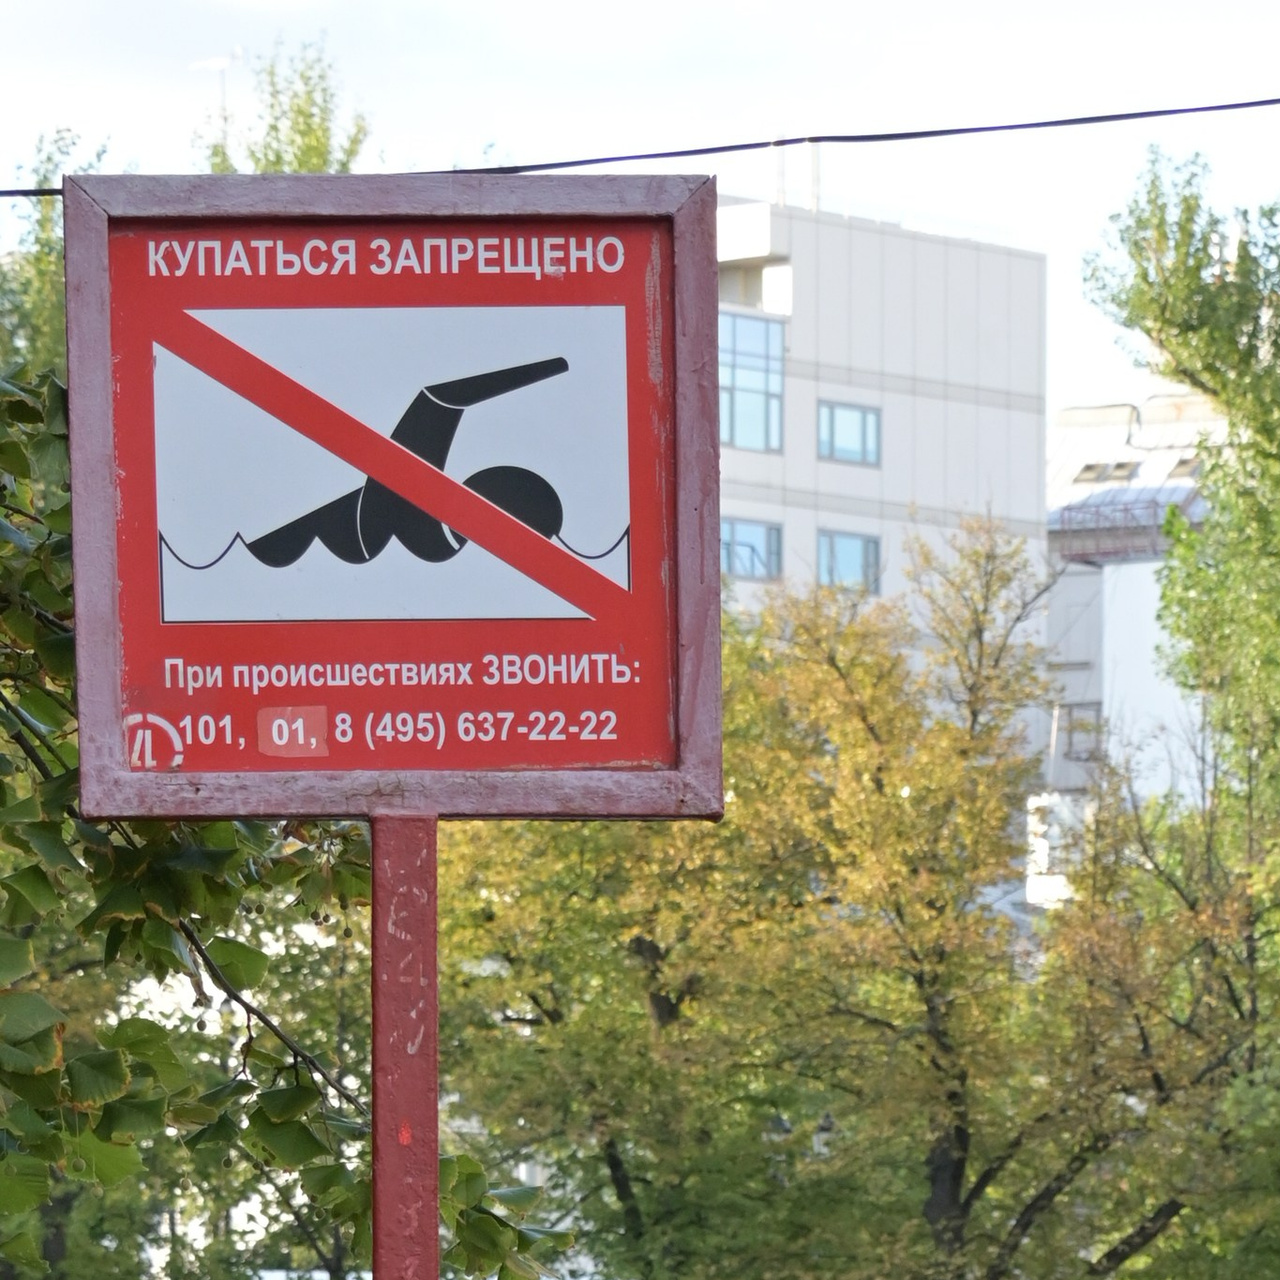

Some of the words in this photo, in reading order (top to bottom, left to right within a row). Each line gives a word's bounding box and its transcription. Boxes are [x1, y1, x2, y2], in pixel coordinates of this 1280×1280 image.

[148, 238, 357, 277] КУПАТЬСЯ
[369, 236, 625, 281] ЗАПРЕЩЕНО
[164, 658, 223, 696] При
[233, 662, 474, 696] происшествиях
[482, 653, 640, 686] ЗВОНИТЬ:
[181, 715, 245, 749] 101,
[272, 718, 317, 749] 01,
[335, 713, 353, 743] 8
[365, 712, 446, 750] (495)
[457, 710, 617, 741] 637-22-22
